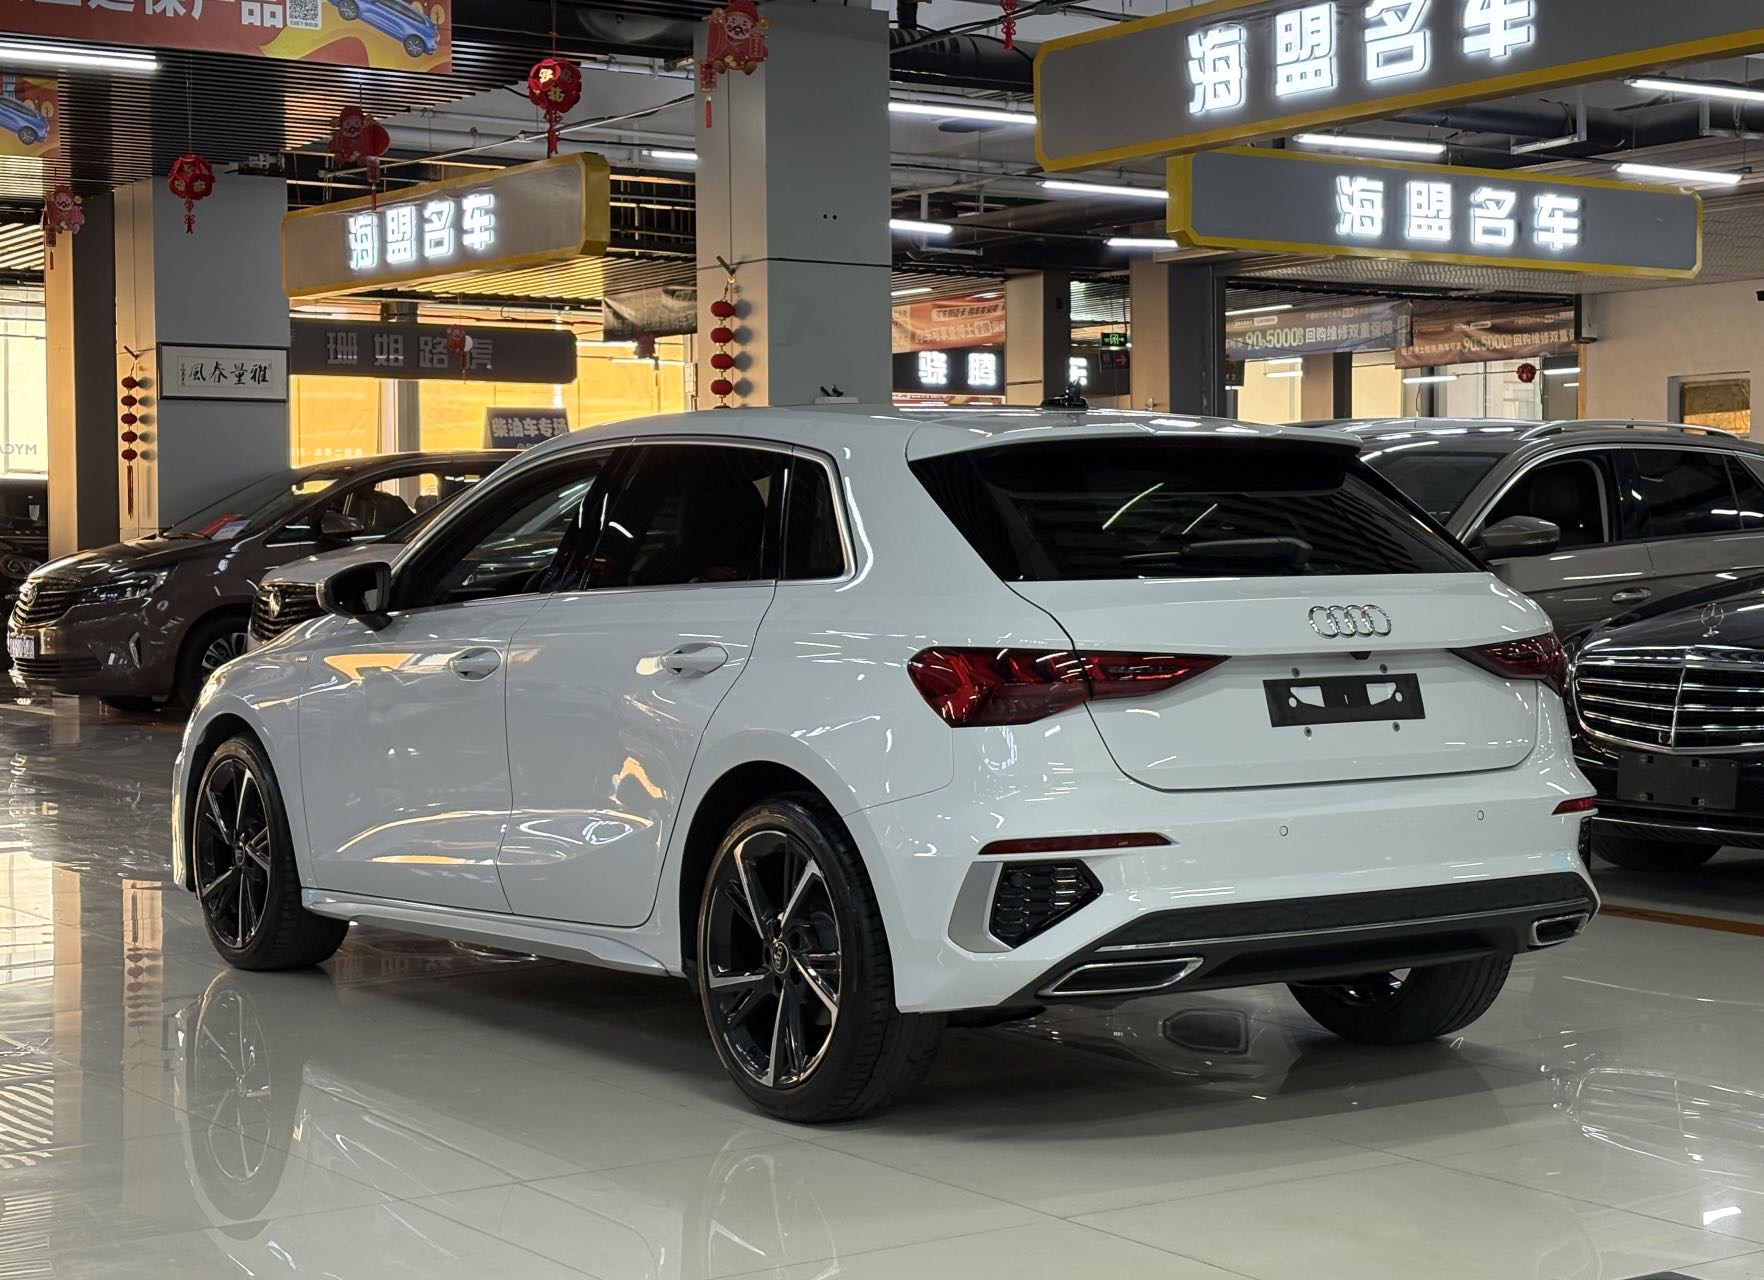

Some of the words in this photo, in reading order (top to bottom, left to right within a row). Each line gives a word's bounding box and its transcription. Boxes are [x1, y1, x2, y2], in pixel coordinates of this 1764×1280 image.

[1188, 0, 1536, 114] 海盟名车
[348, 193, 496, 271] 海盟名车
[1335, 175, 1580, 249] 海盟名车
